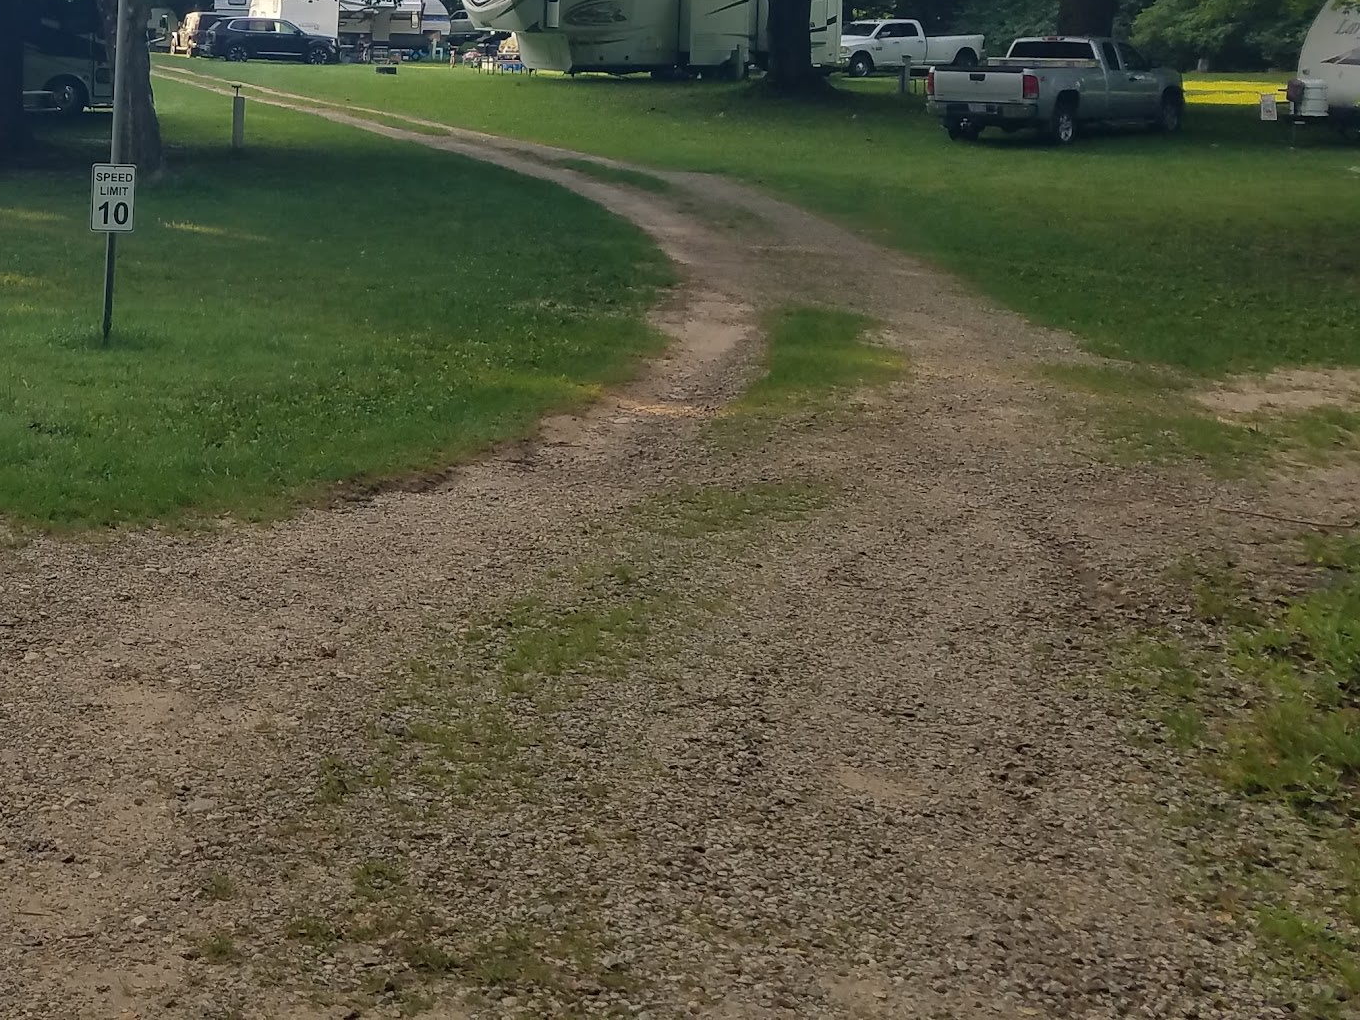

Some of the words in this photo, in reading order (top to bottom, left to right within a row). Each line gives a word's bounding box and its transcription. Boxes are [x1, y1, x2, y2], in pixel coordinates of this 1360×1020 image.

[95, 172, 134, 183] SPEED
[99, 186, 129, 196] LIMIT
[98, 201, 129, 226] 10
